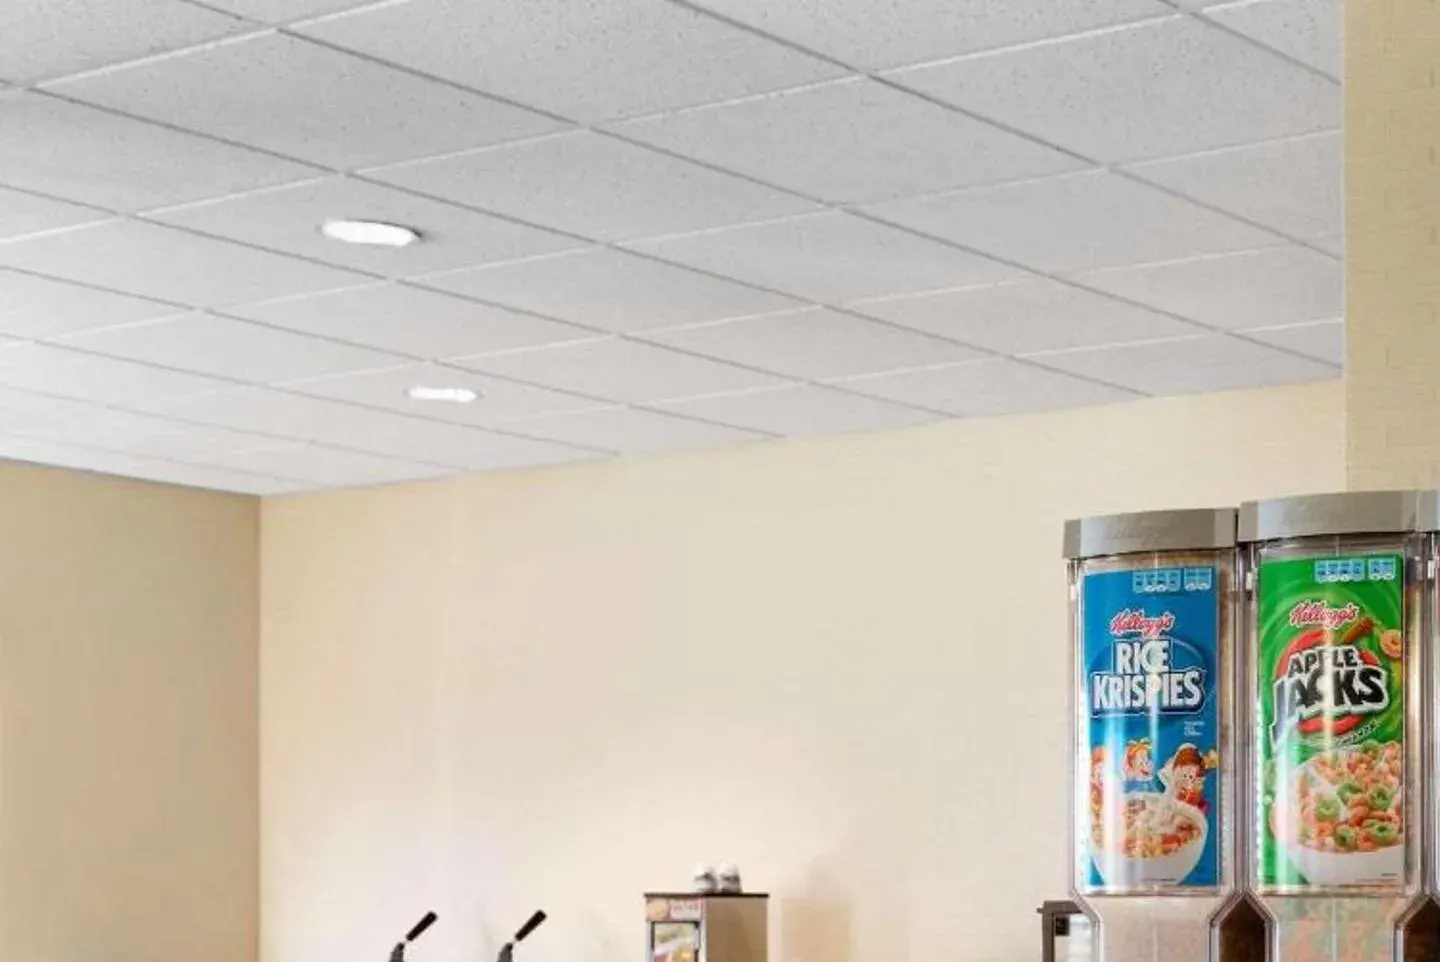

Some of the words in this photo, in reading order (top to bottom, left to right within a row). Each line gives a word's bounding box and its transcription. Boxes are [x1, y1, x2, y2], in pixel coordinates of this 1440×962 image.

[1110, 609, 1175, 637] Kellogg's
[1289, 600, 1359, 630] Kellogg's
[1114, 640, 1172, 673] RICE
[1094, 671, 1202, 710] KRISPIES
